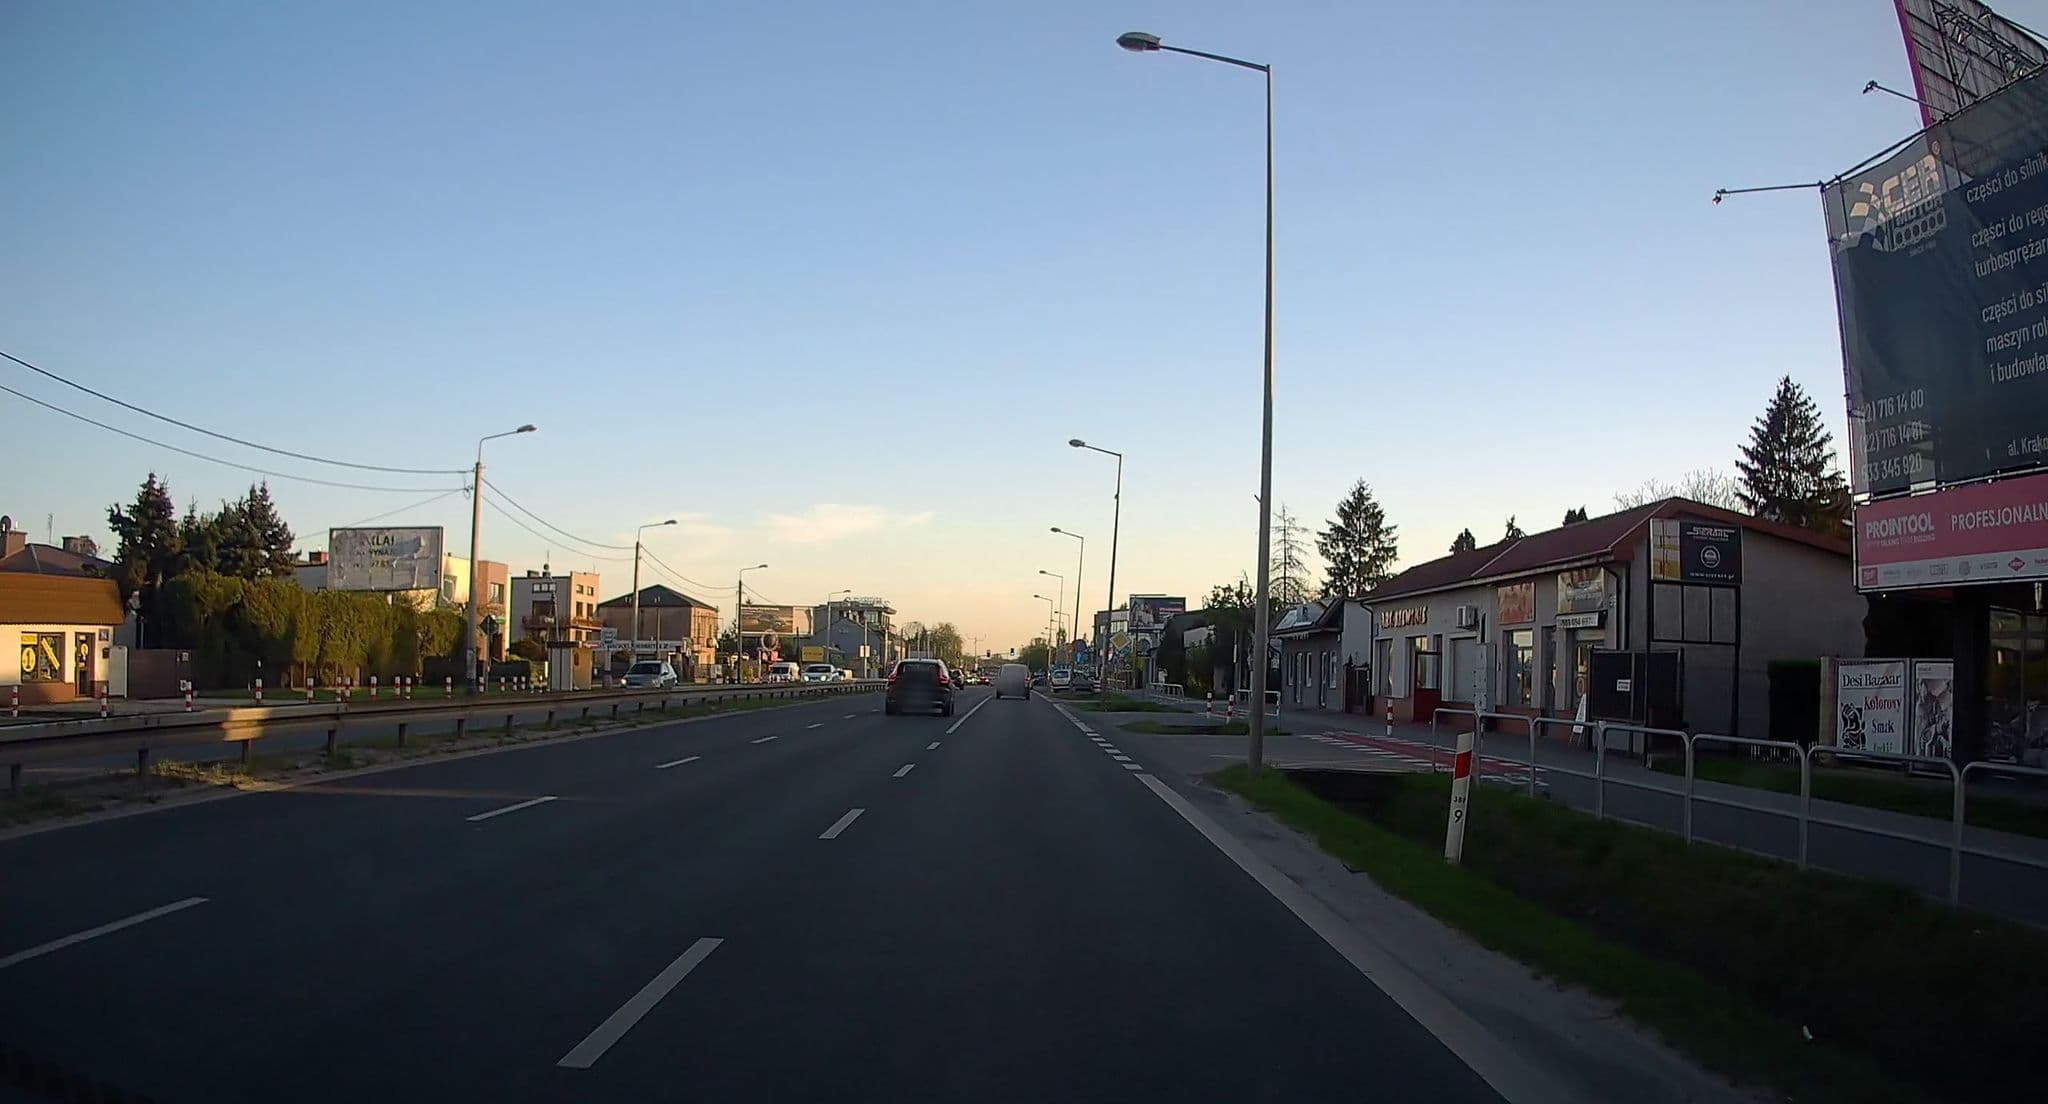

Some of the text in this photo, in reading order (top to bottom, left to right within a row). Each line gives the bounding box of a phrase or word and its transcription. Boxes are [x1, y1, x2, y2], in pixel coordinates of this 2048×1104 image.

[1966, 171, 2002, 203] części
[2004, 167, 2018, 189] do
[1971, 217, 2006, 248] części
[2009, 212, 2023, 233] do
[1974, 237, 2048, 278] turbosprężar
[1982, 291, 2017, 323] części
[2019, 289, 2034, 310] do
[1986, 315, 2048, 354] maszyn rol
[1990, 363, 1995, 385] i
[1877, 396, 1894, 418] 716
[1896, 394, 1907, 414] 14
[1910, 388, 1924, 410] 80
[1880, 426, 1897, 449] 716
[1898, 424, 1910, 444] 14
[1911, 420, 1923, 441] 81
[2008, 438, 2019, 457] al.
[1881, 457, 1901, 479] 345
[1902, 452, 1922, 476] 920
[1865, 512, 1935, 539] PROINTOOL
[1843, 672, 1901, 687] Desi Bazaar
[1863, 695, 1901, 712] Kolorowy
[1872, 718, 1894, 734] Smak
[1455, 810, 1463, 823] 9
